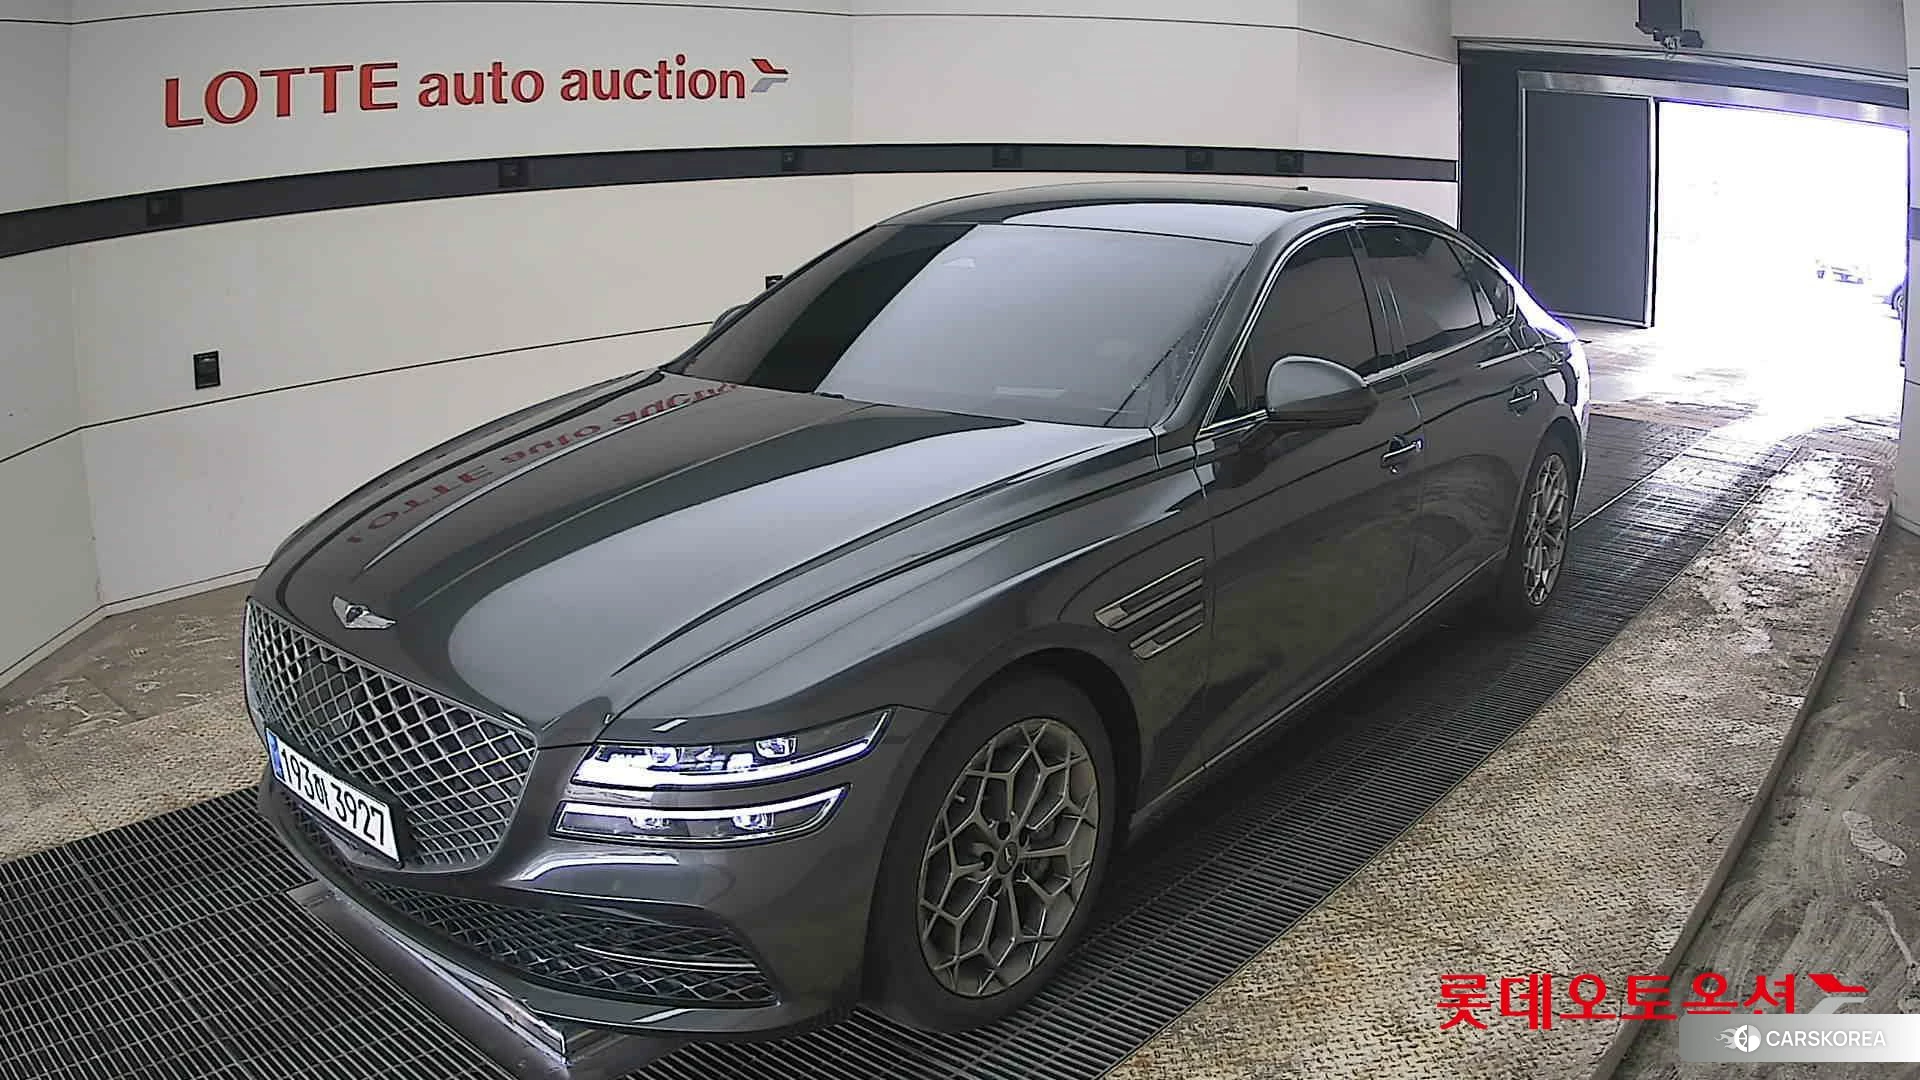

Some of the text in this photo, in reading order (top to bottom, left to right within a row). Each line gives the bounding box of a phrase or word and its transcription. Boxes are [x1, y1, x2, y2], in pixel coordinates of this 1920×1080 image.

[164, 54, 747, 128] LOTTE auto auction
[331, 782, 385, 846] 3927
